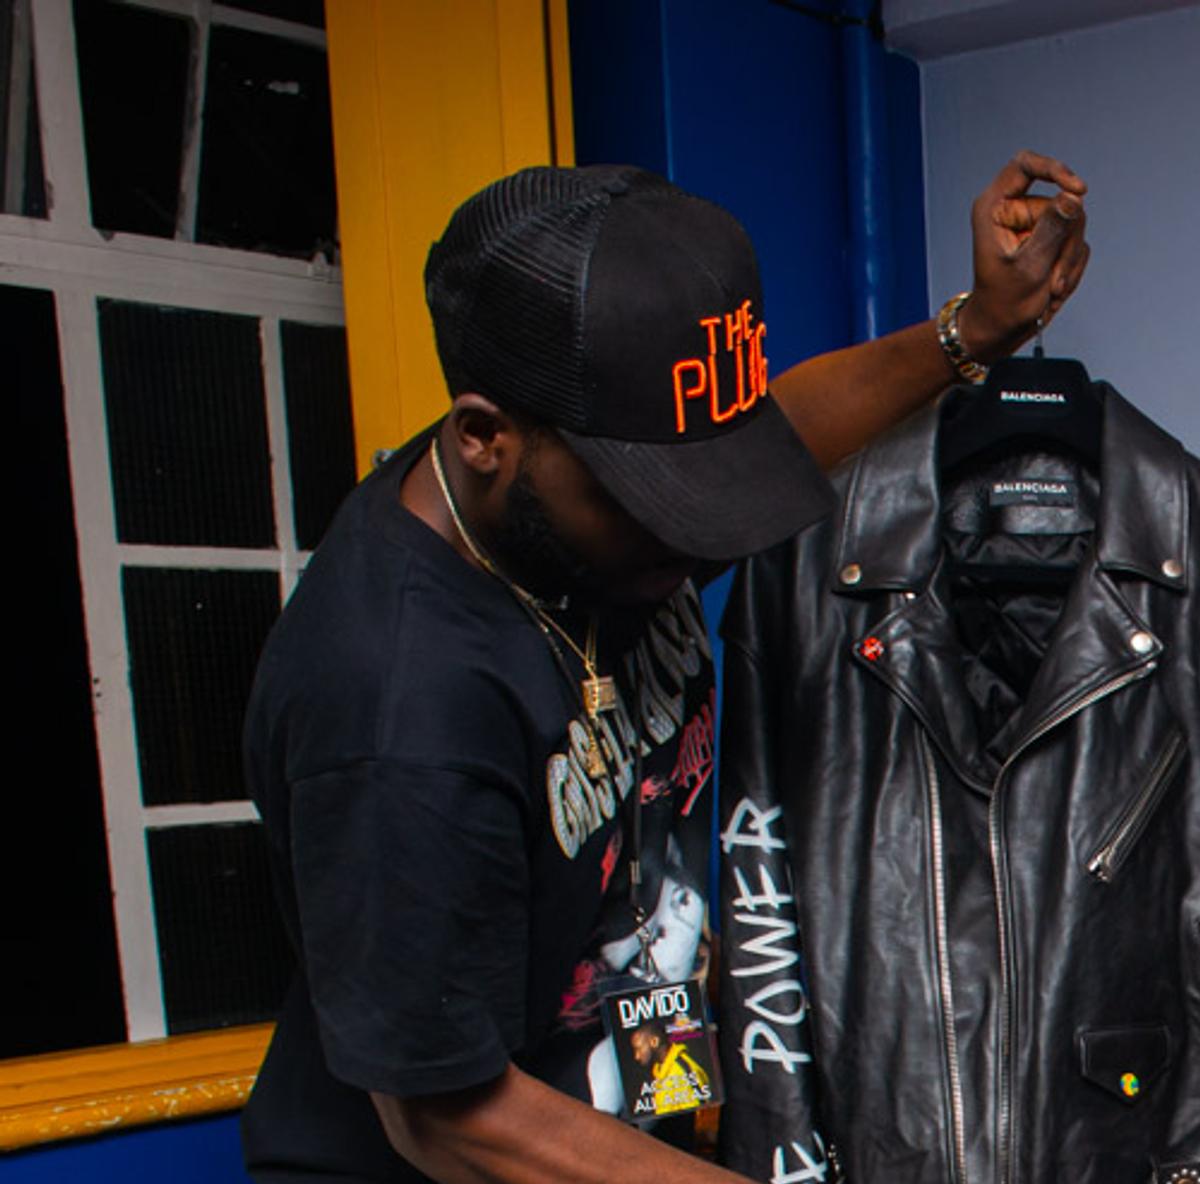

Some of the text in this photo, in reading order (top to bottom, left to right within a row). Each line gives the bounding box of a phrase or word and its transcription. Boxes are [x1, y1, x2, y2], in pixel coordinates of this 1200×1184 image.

[699, 299, 754, 355] THE
[672, 321, 768, 434] PLUG
[1000, 390, 1065, 403] BALENCIAGA
[993, 482, 1068, 494] BALENCIAGA
[720, 797, 812, 1074] POWER
[618, 984, 689, 1029] DAVIDO
